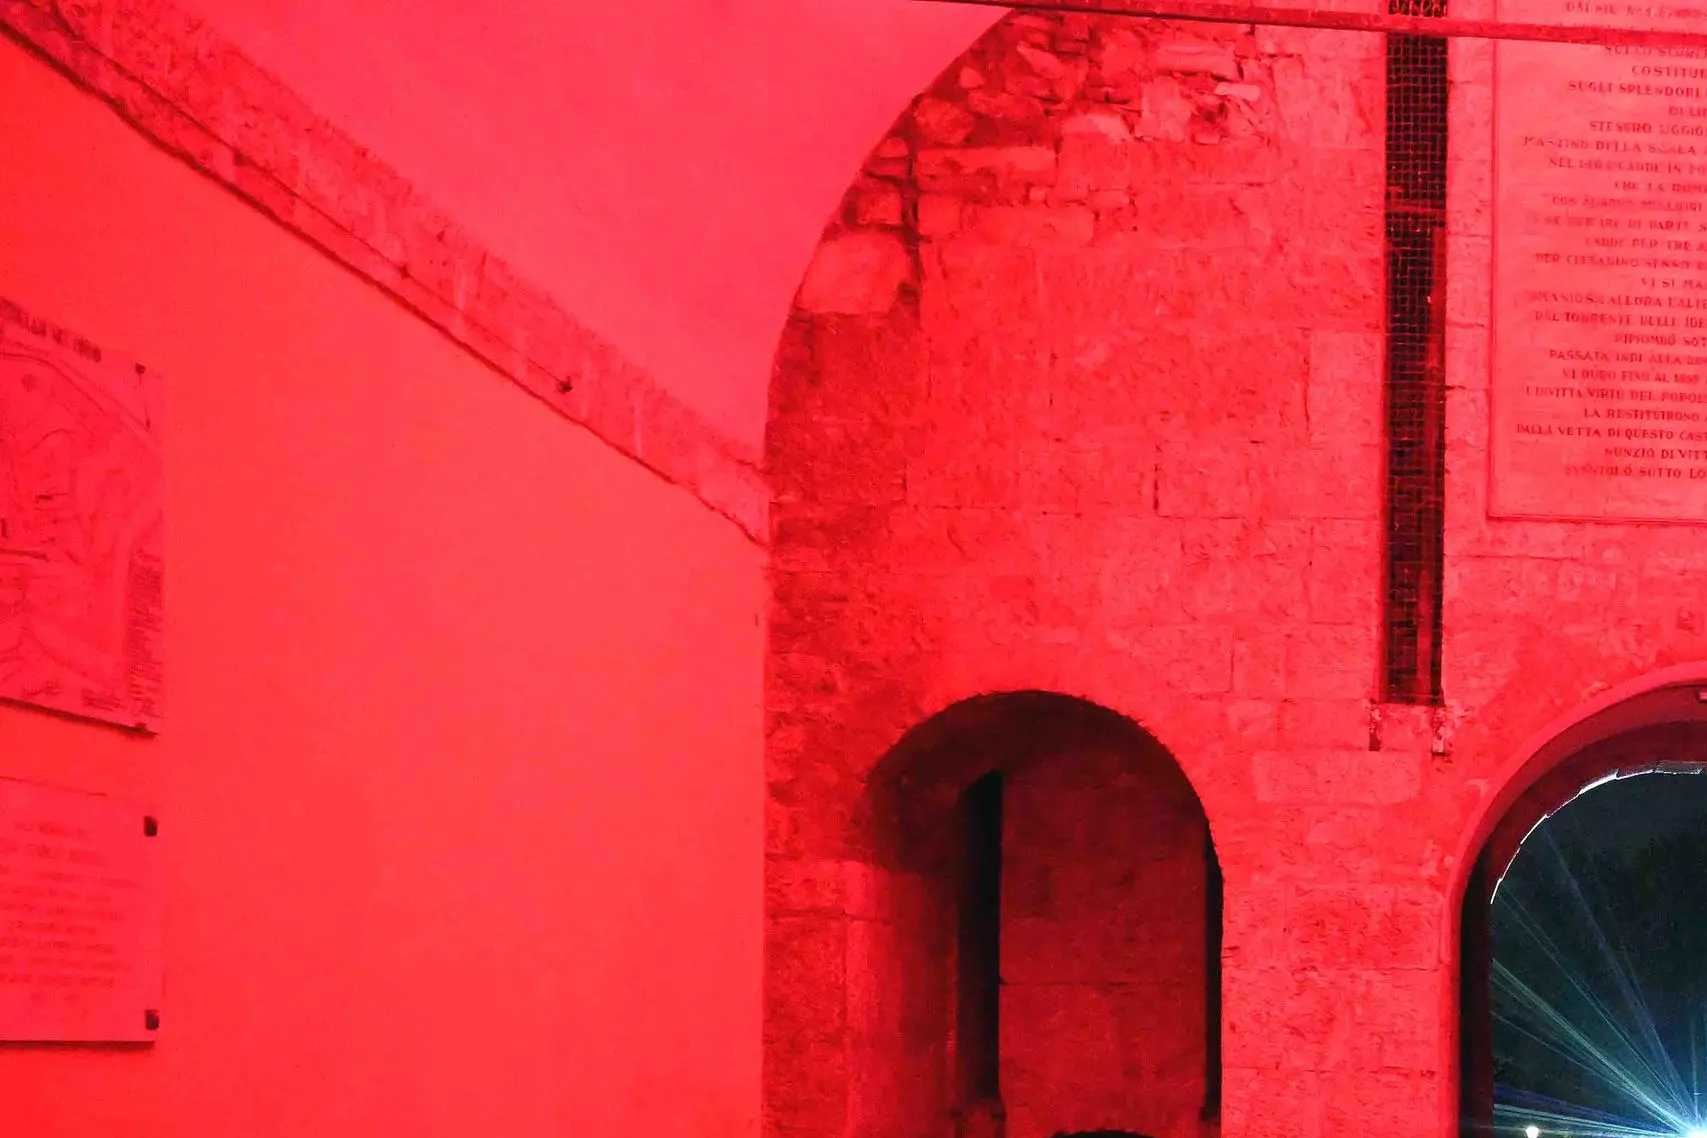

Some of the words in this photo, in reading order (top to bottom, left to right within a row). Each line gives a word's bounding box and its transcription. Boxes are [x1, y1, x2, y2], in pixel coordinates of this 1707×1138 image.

[1595, 140, 1641, 153] DELLA
[1633, 238, 1658, 249] PER
[1667, 240, 1691, 251] TRE
[1641, 277, 1654, 287] VI
[1662, 278, 1675, 288] SI
[1550, 349, 1609, 361] PASSATA
[1649, 354, 1682, 365] ALLA
[1562, 368, 1575, 379] VI
[1655, 372, 1669, 383] AL
[1630, 390, 1652, 401] DEL
[1584, 408, 1600, 418] LA
[1558, 425, 1601, 437] VETTA
[1608, 428, 1619, 438] DI
[1625, 428, 1673, 440] QUESTO
[1605, 446, 1655, 458] NUNZIO
[1661, 449, 1675, 459] DI
[1639, 466, 1681, 479] SOTTO
[1689, 468, 1706, 480] LO
